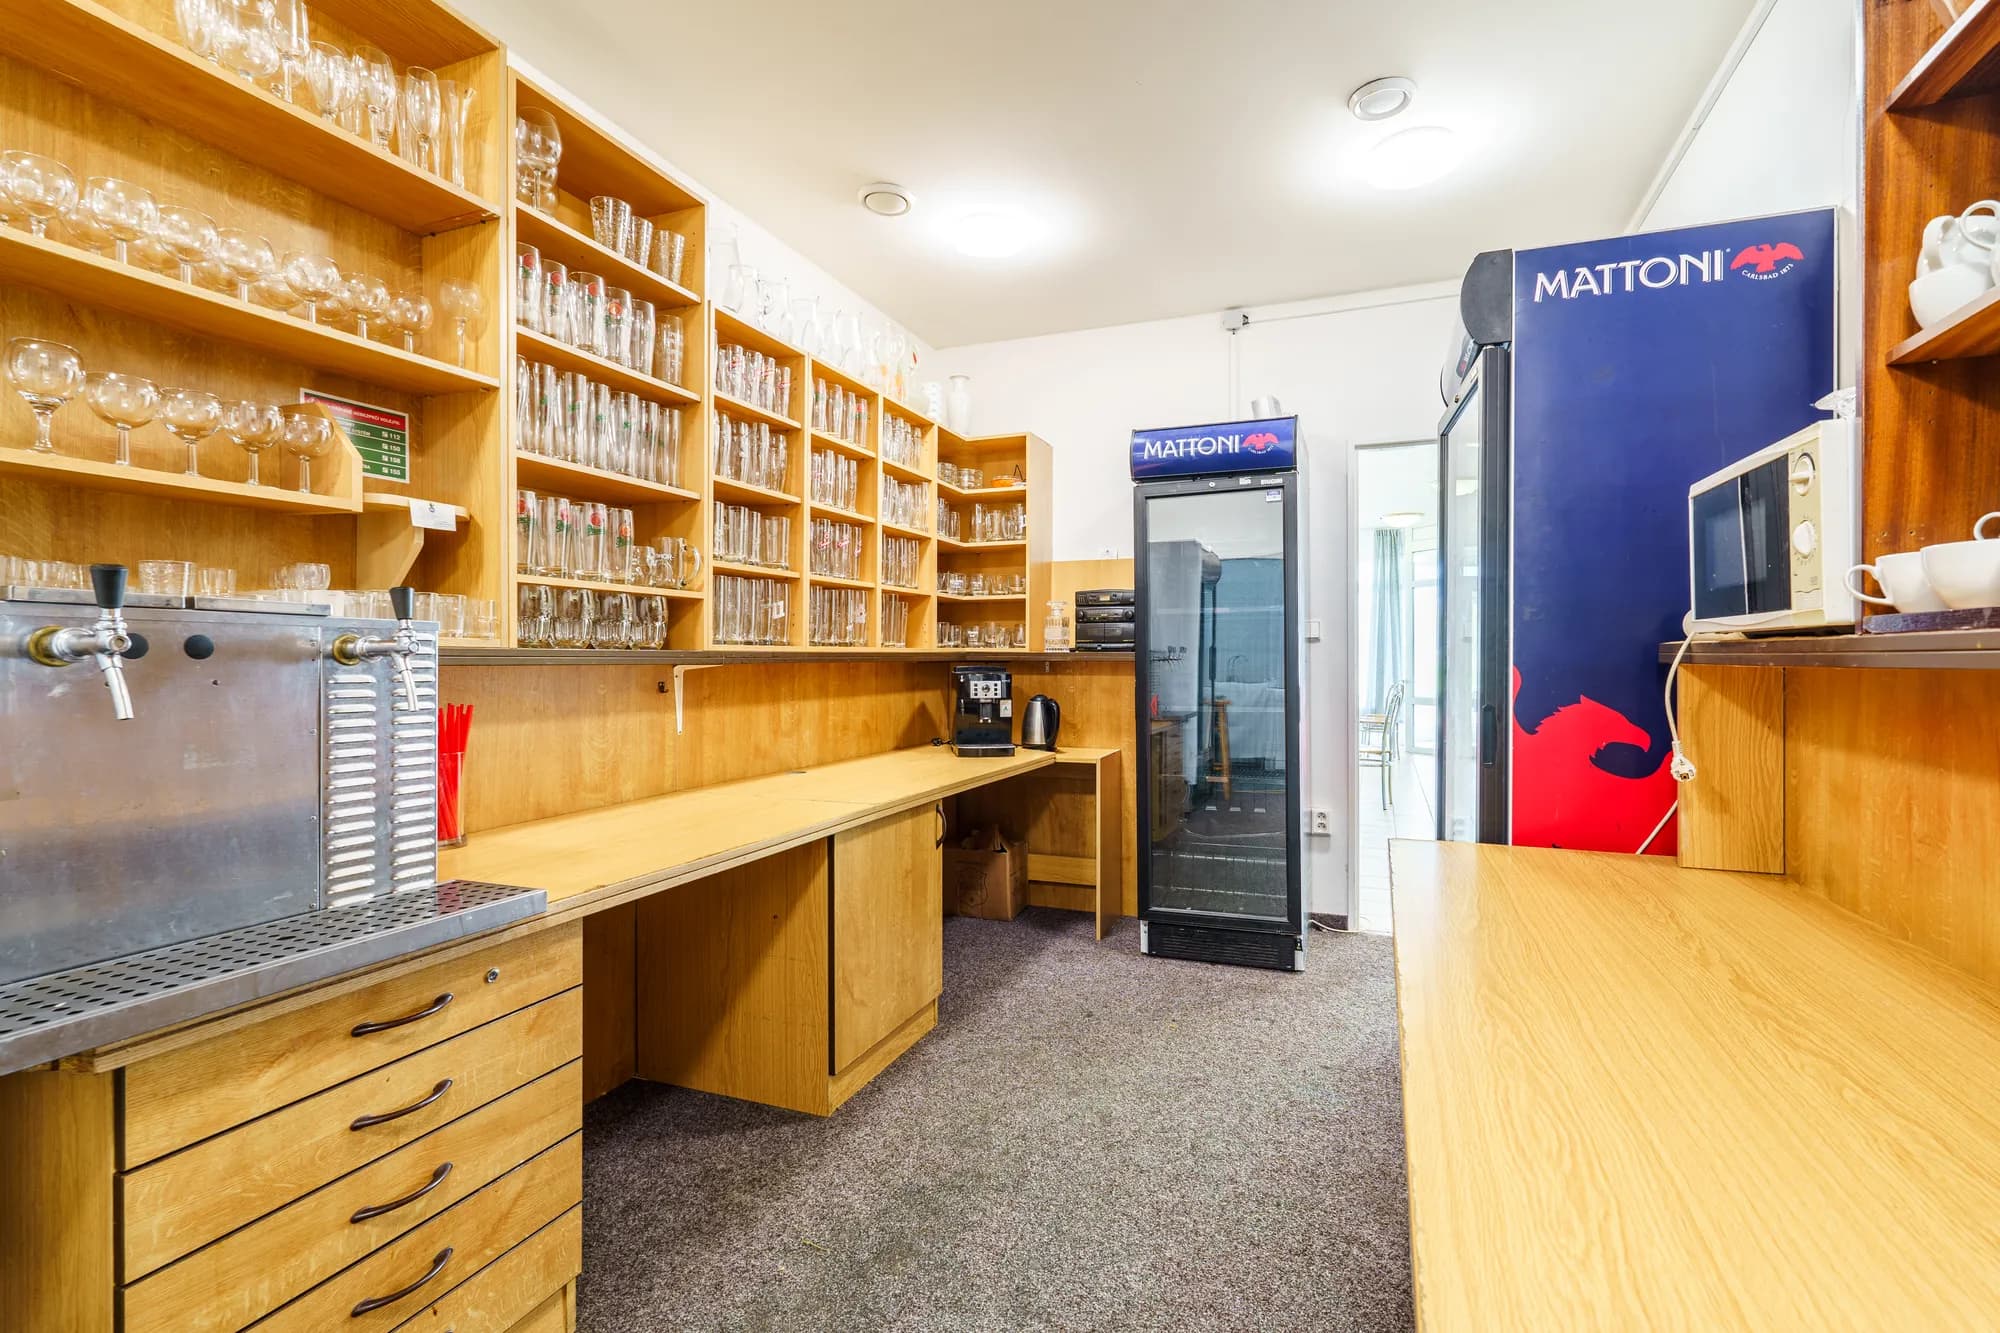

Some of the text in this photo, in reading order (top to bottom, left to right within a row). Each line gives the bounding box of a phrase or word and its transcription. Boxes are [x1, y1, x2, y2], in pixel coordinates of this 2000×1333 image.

[1534, 249, 1724, 303] MATTONI
[1741, 269, 1779, 280] CARLSBAD
[1143, 434, 1241, 460] MATTONI
